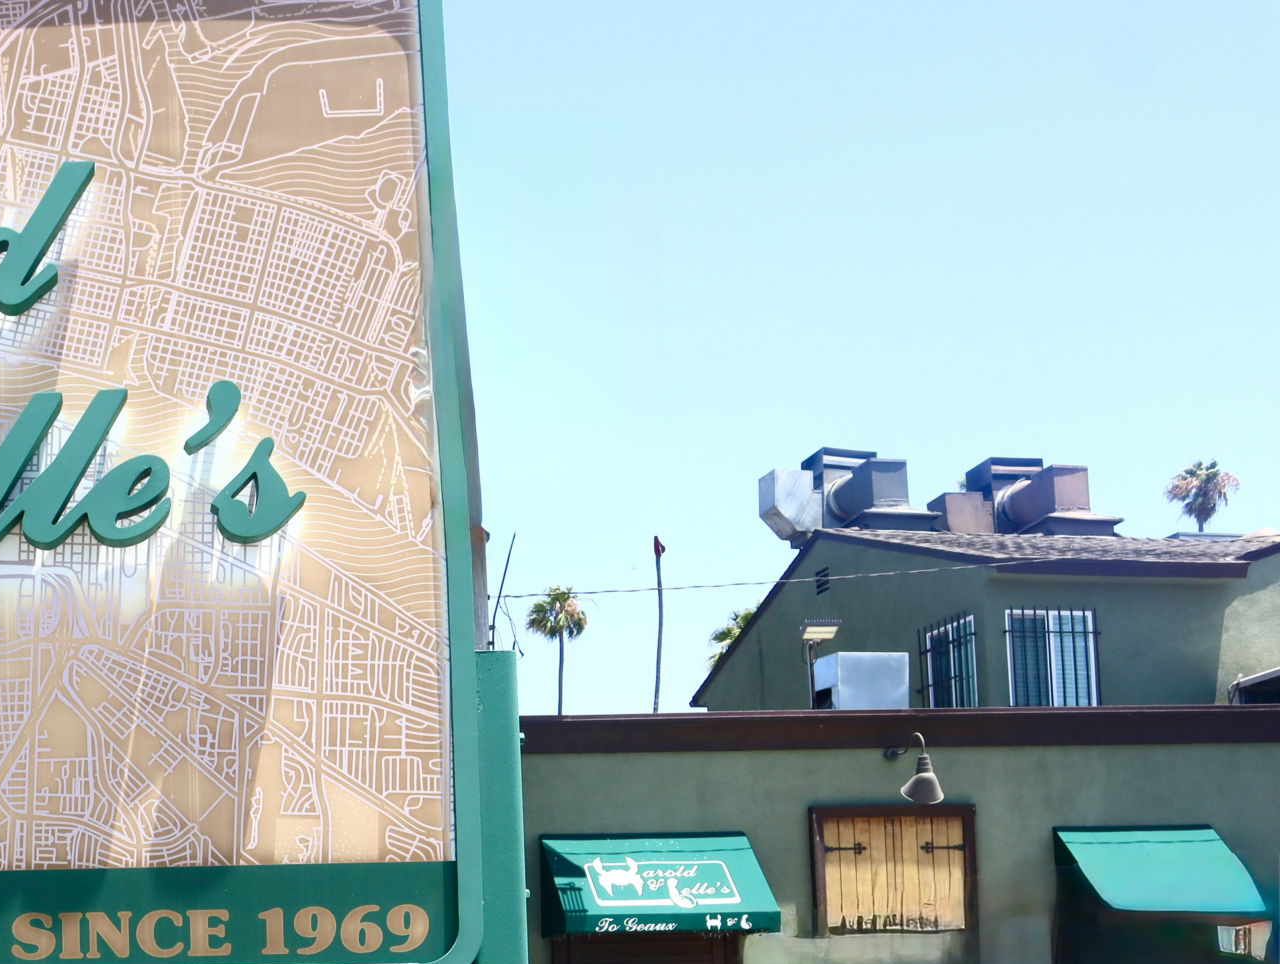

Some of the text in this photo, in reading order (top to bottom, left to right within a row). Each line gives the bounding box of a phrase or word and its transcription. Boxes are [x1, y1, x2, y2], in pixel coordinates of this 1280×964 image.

[11, 909, 232, 961] SINCE
[258, 904, 430, 955] 1969
[595, 917, 620, 932] To
[623, 917, 678, 932] Geaux
